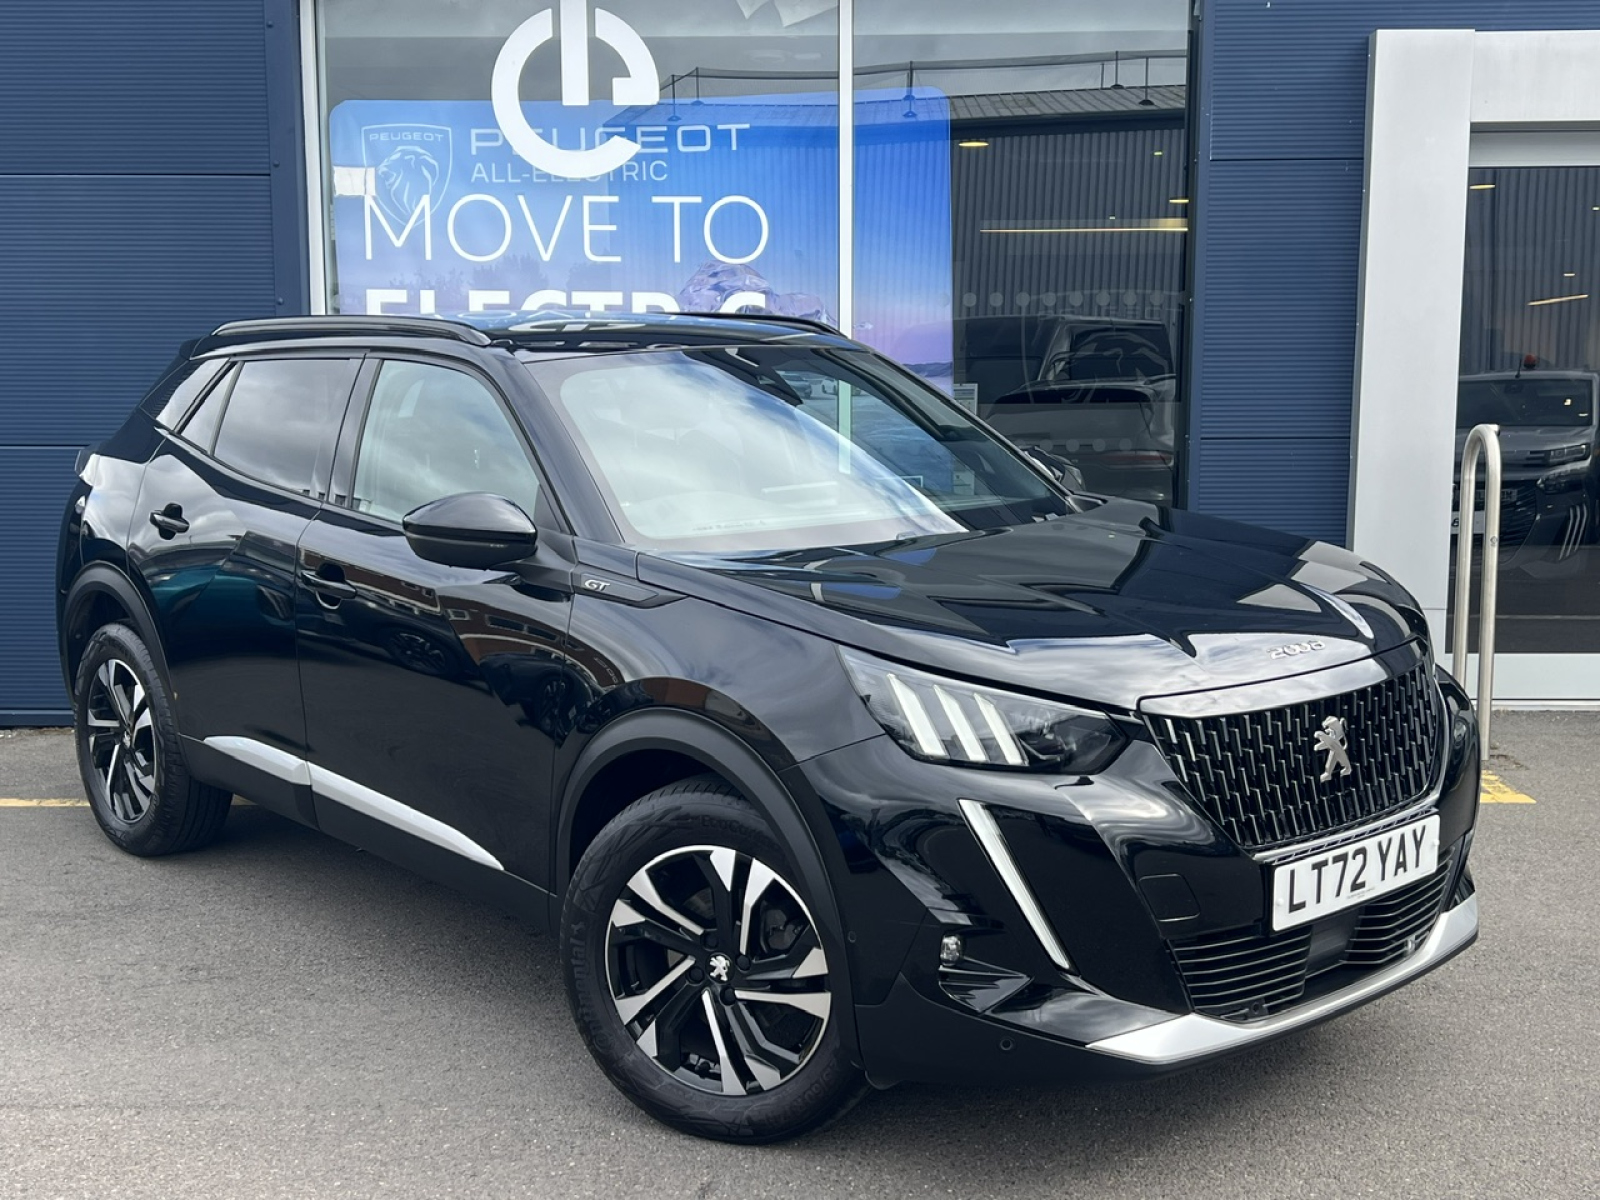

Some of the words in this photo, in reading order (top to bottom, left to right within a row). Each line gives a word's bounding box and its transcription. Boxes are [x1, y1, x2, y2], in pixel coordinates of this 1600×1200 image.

[369, 132, 444, 143] PEUGEOT
[470, 123, 750, 155] PUGEOT
[364, 194, 621, 262] MOVE
[652, 195, 769, 264] TO
[584, 579, 610, 592] GT
[1267, 640, 1326, 660] 2008
[1288, 846, 1368, 914] LT72
[1377, 825, 1427, 882] YAY
